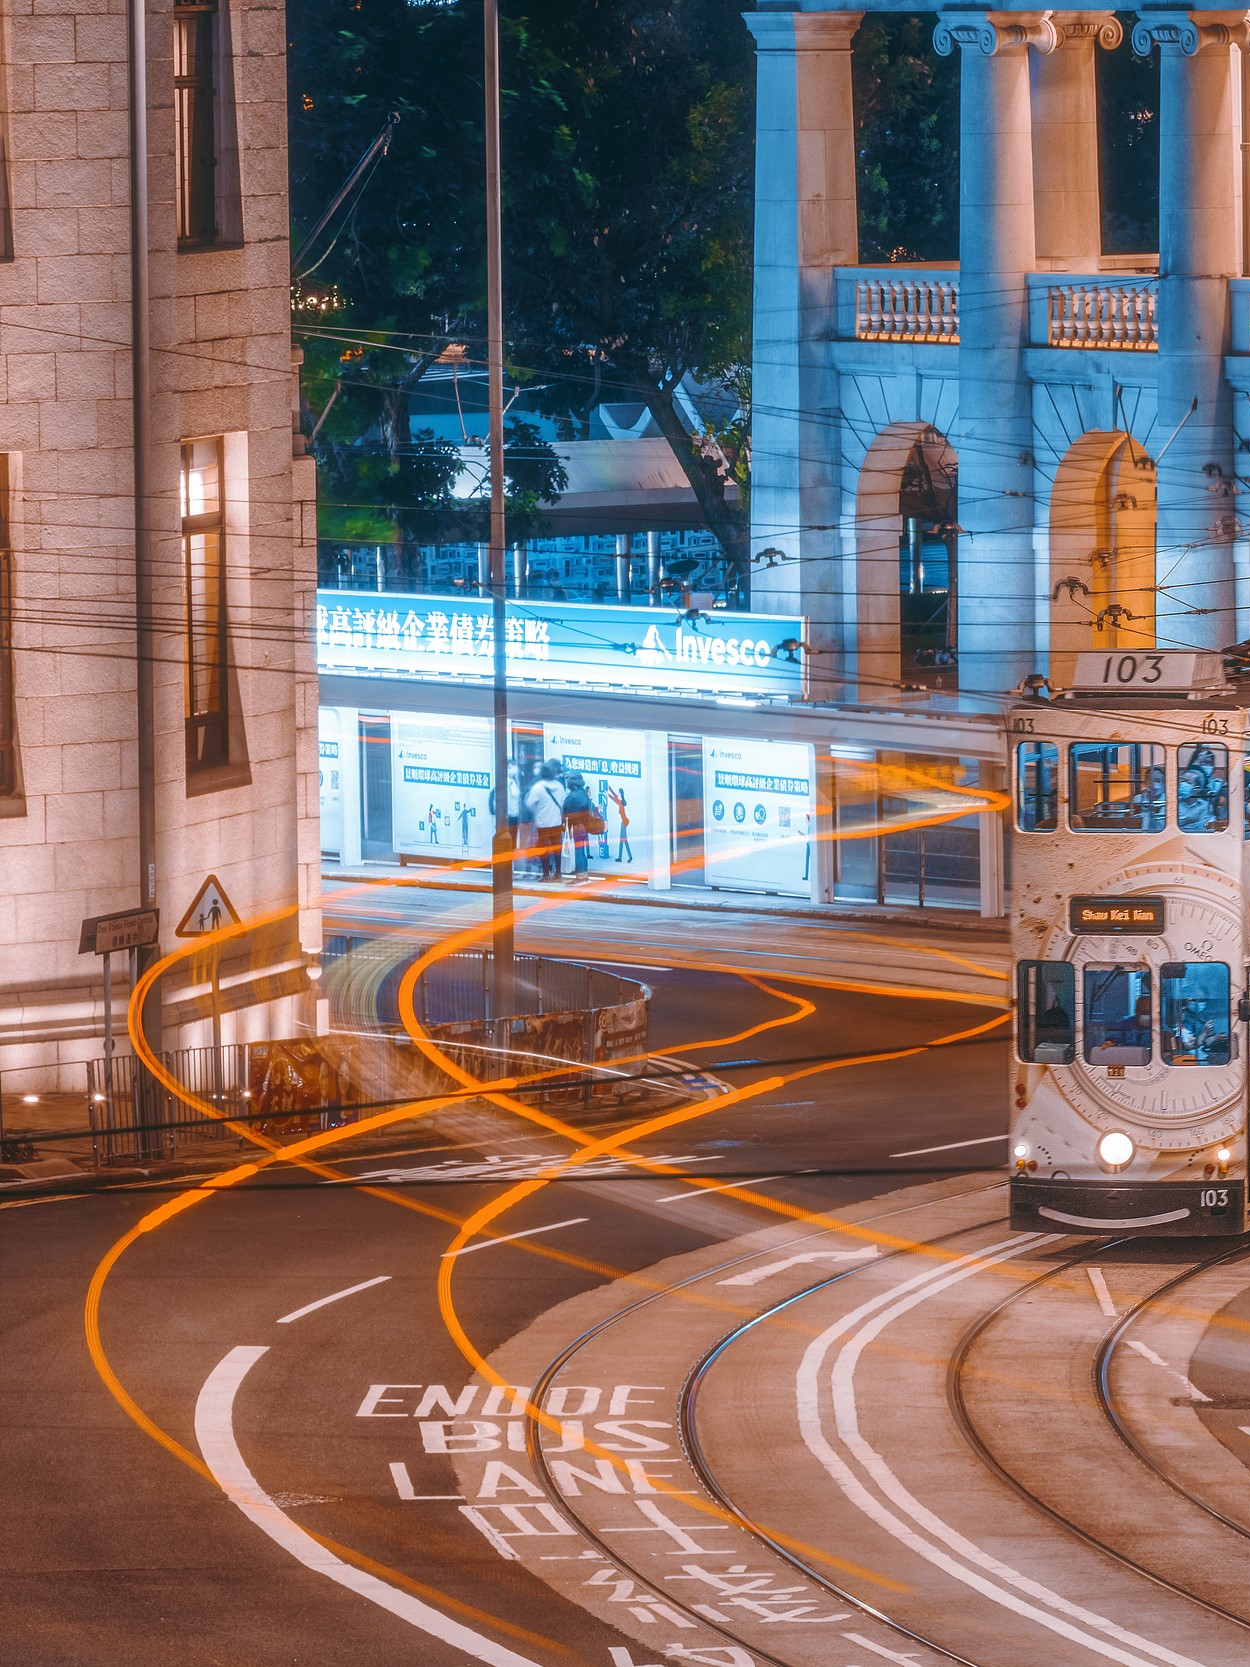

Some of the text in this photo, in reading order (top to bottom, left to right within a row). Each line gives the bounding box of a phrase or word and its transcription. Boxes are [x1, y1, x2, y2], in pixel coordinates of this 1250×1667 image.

[675, 626, 771, 667] Invesco
[1102, 655, 1165, 684] 103
[1202, 719, 1229, 735] 103
[560, 735, 582, 746] Invesco
[407, 751, 427, 761] Invesco
[720, 750, 742, 760] Invesco
[1082, 909, 1108, 921] Shau
[1110, 909, 1130, 921] Kei
[1200, 1189, 1229, 1207] 103
[356, 1384, 665, 1417] END OF
[419, 1420, 675, 1454] BUS
[389, 1459, 699, 1500] LANE
